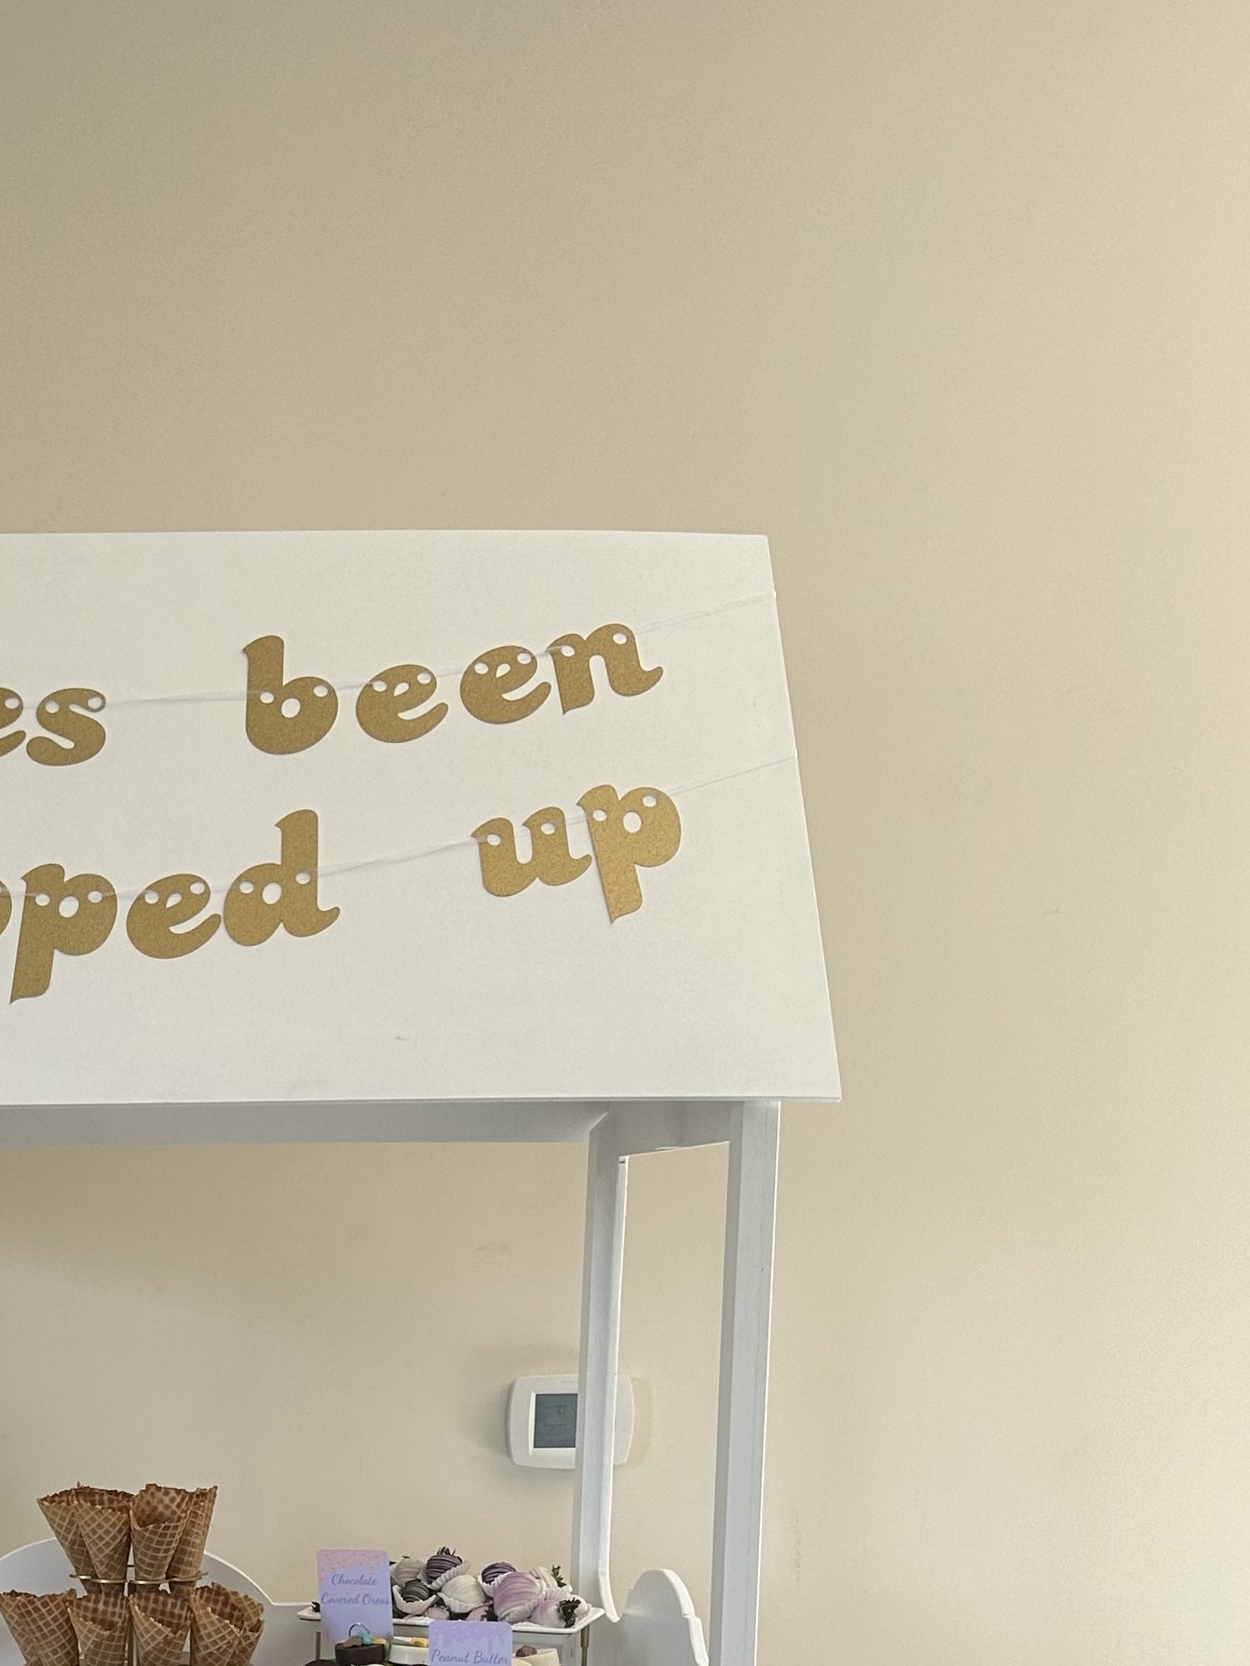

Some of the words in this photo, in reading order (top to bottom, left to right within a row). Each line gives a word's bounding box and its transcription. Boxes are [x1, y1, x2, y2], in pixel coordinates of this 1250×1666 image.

[243, 622, 664, 755] been
[470, 783, 682, 926] up
[331, 1573, 377, 1585] Chocolate
[321, 1592, 359, 1604] Covered
[362, 1593, 389, 1605] Oreos
[431, 1649, 470, 1663] Peanut
[474, 1651, 508, 1664] Butter
